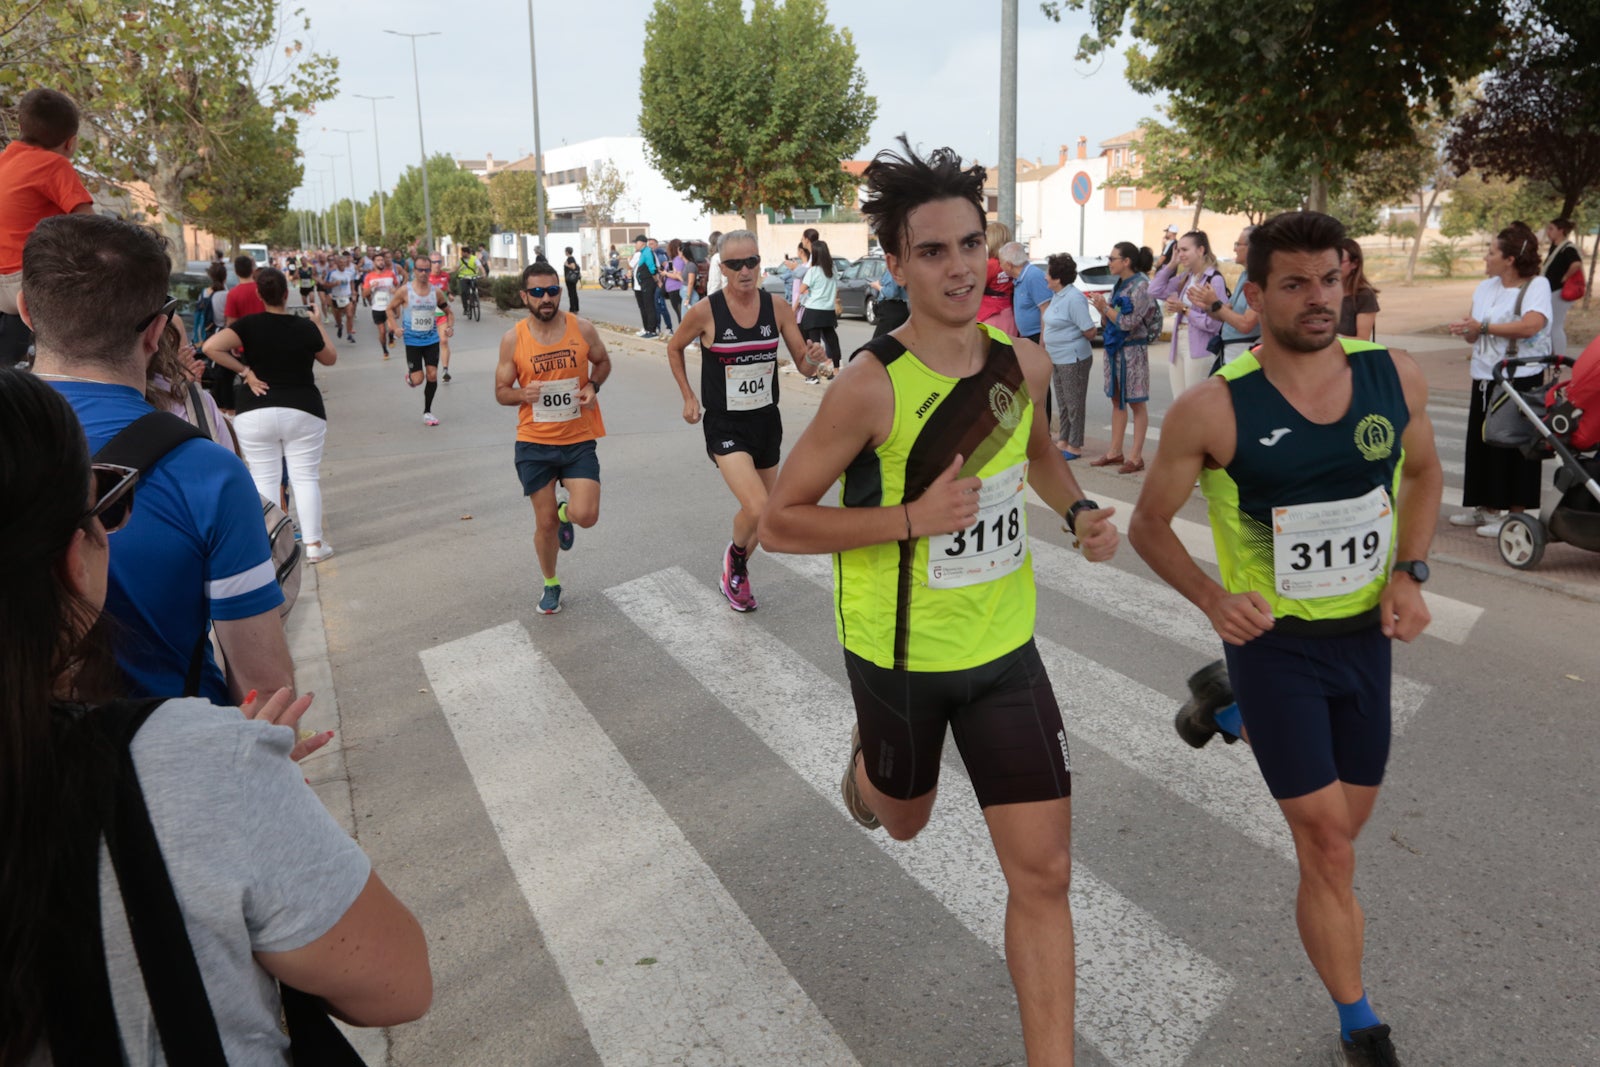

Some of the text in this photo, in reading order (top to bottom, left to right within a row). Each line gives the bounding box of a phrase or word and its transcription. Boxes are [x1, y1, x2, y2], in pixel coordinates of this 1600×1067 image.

[738, 377, 765, 394] 404
[543, 393, 571, 407] 806
[915, 391, 940, 419] Joma
[944, 507, 1019, 557] 3118
[1290, 530, 1379, 571] 3119
